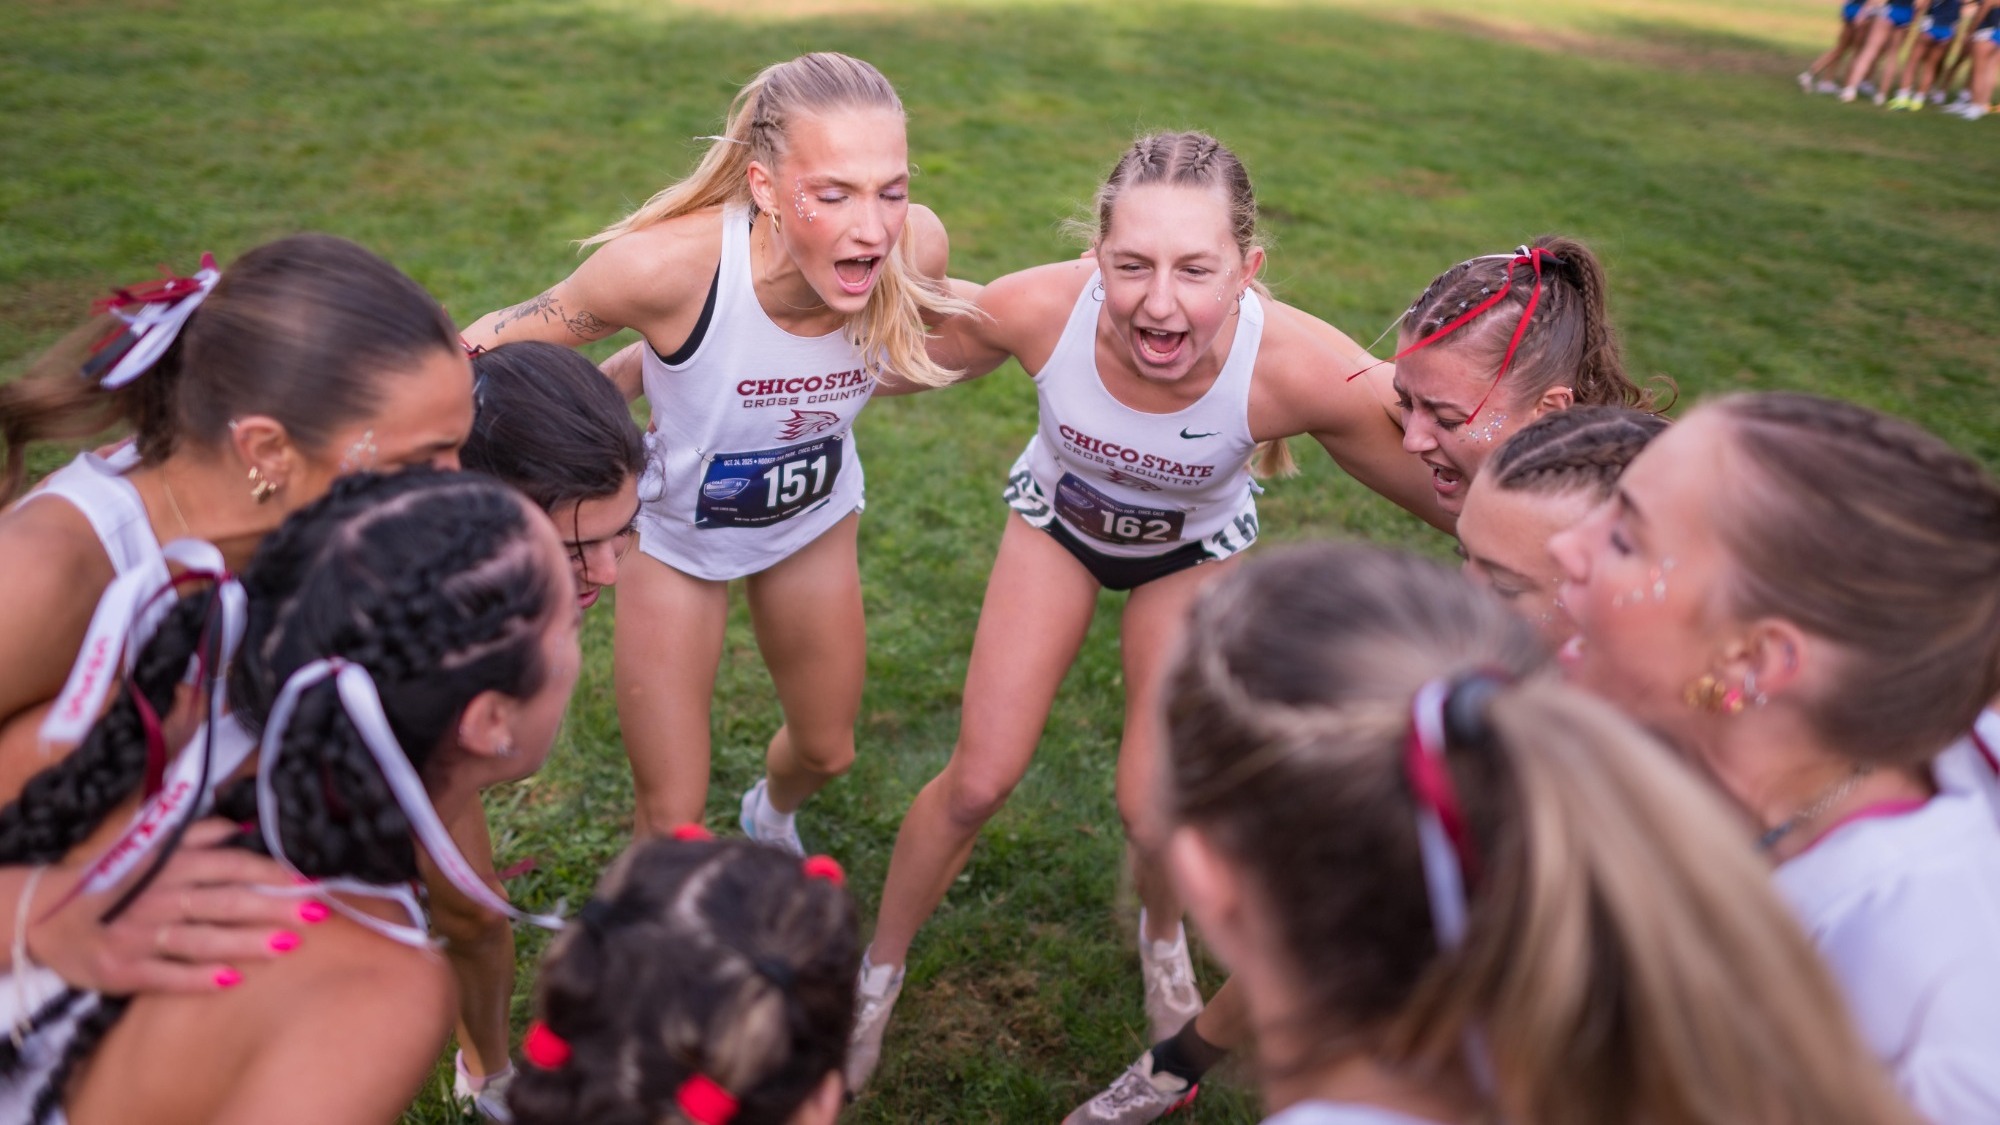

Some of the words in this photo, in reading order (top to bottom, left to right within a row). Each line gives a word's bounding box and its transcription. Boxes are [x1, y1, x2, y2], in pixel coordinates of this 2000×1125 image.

[737, 376, 823, 396] CHICO
[823, 362, 880, 391] STA
[743, 397, 799, 408] CROSS
[807, 380, 874, 404] COUNTRY
[1059, 424, 1140, 463] CHICO
[1141, 453, 1215, 478] STATE
[1063, 441, 1116, 468] CROSS
[1124, 464, 1205, 487] COUNTRY
[763, 454, 827, 508] 151
[1100, 509, 1172, 541] 162
